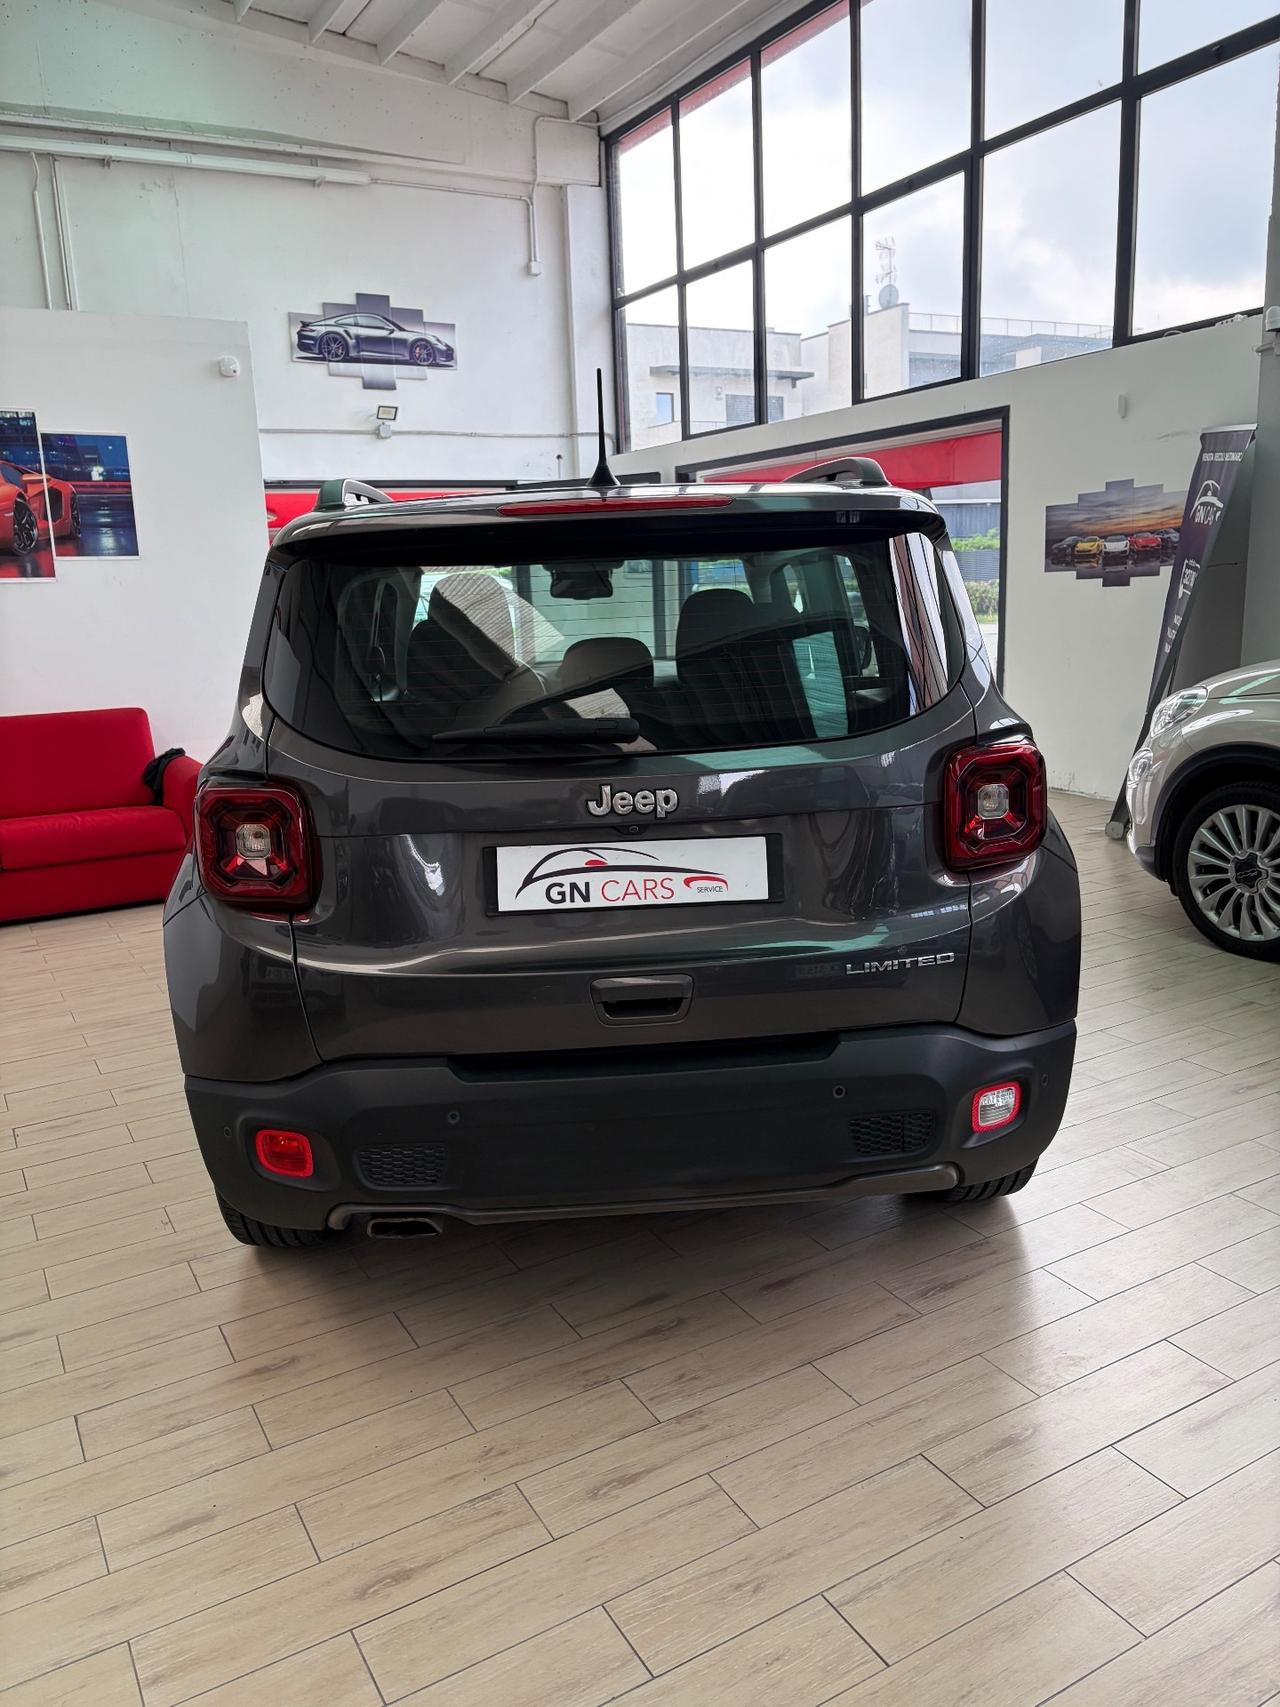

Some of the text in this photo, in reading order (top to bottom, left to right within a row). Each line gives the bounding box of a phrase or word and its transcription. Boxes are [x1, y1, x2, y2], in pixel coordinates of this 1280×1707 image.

[587, 785, 679, 818] Jeep
[545, 877, 675, 904] GN CARS
[696, 885, 724, 894] SERVICE
[846, 952, 955, 975] LIMITED
